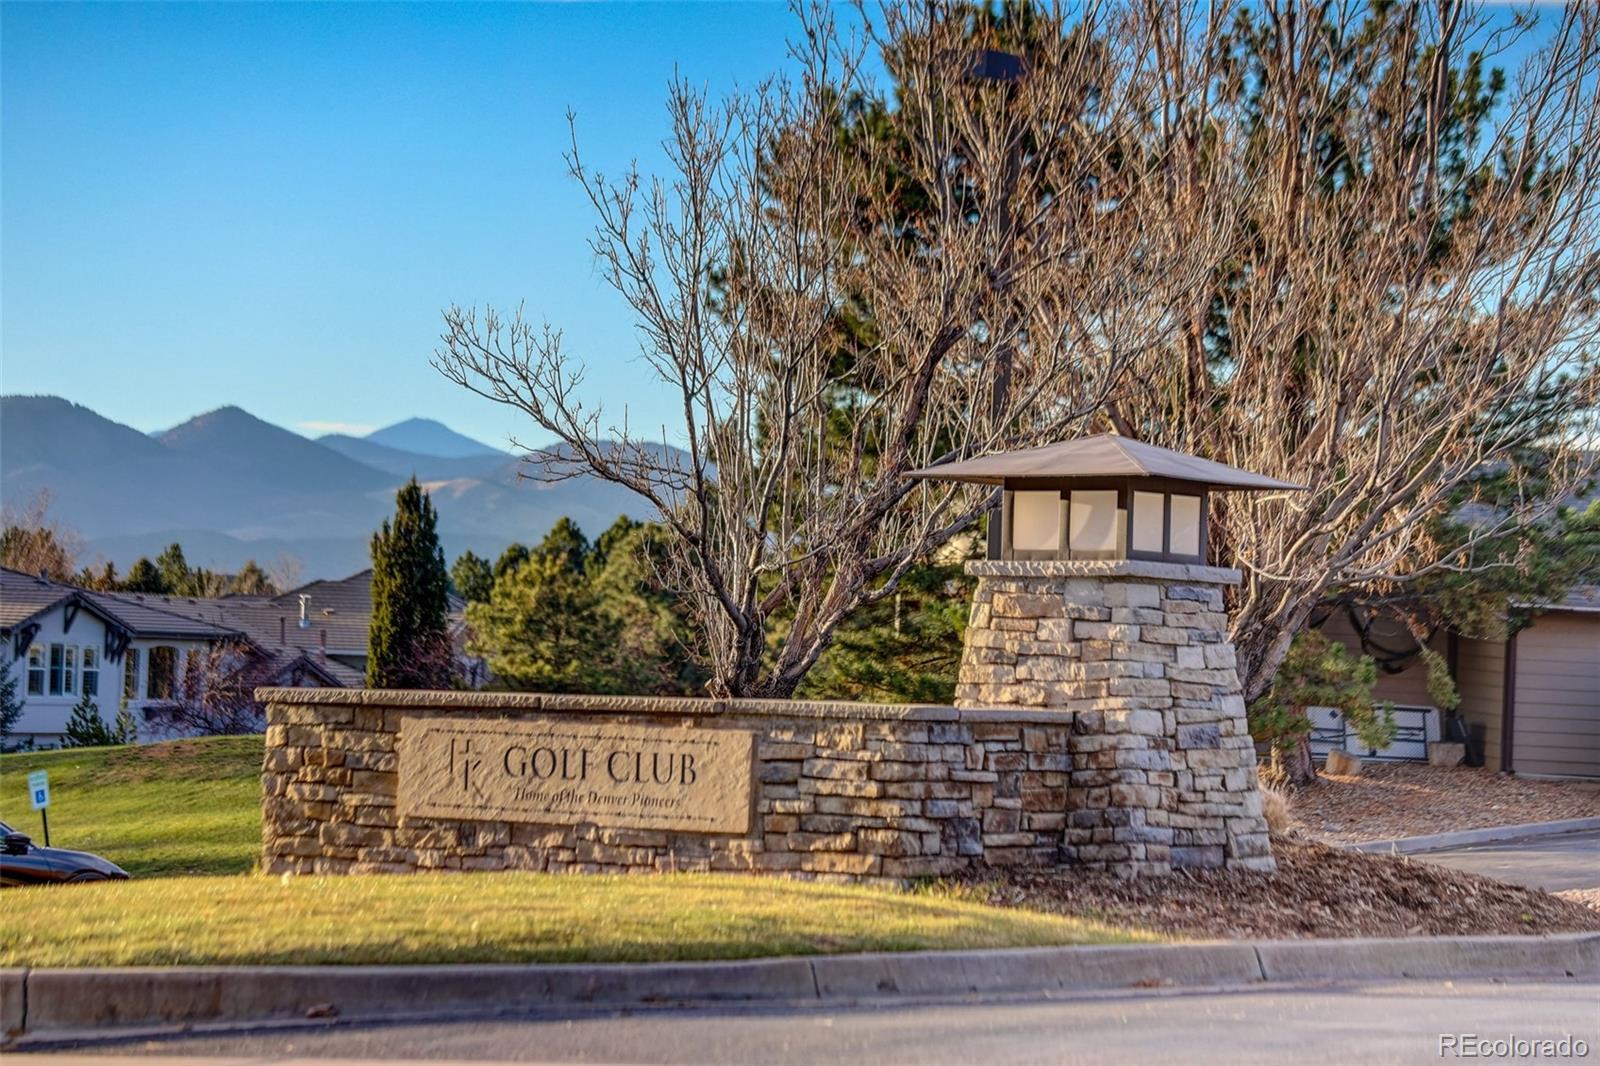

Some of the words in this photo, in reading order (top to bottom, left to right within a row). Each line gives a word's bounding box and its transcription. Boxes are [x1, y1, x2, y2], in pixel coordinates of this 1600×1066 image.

[503, 746, 594, 781] GOLF
[607, 751, 697, 786] CLUB
[513, 787, 549, 802] Home
[552, 788, 567, 805] of
[566, 788, 584, 804] the
[588, 791, 629, 806] Denver
